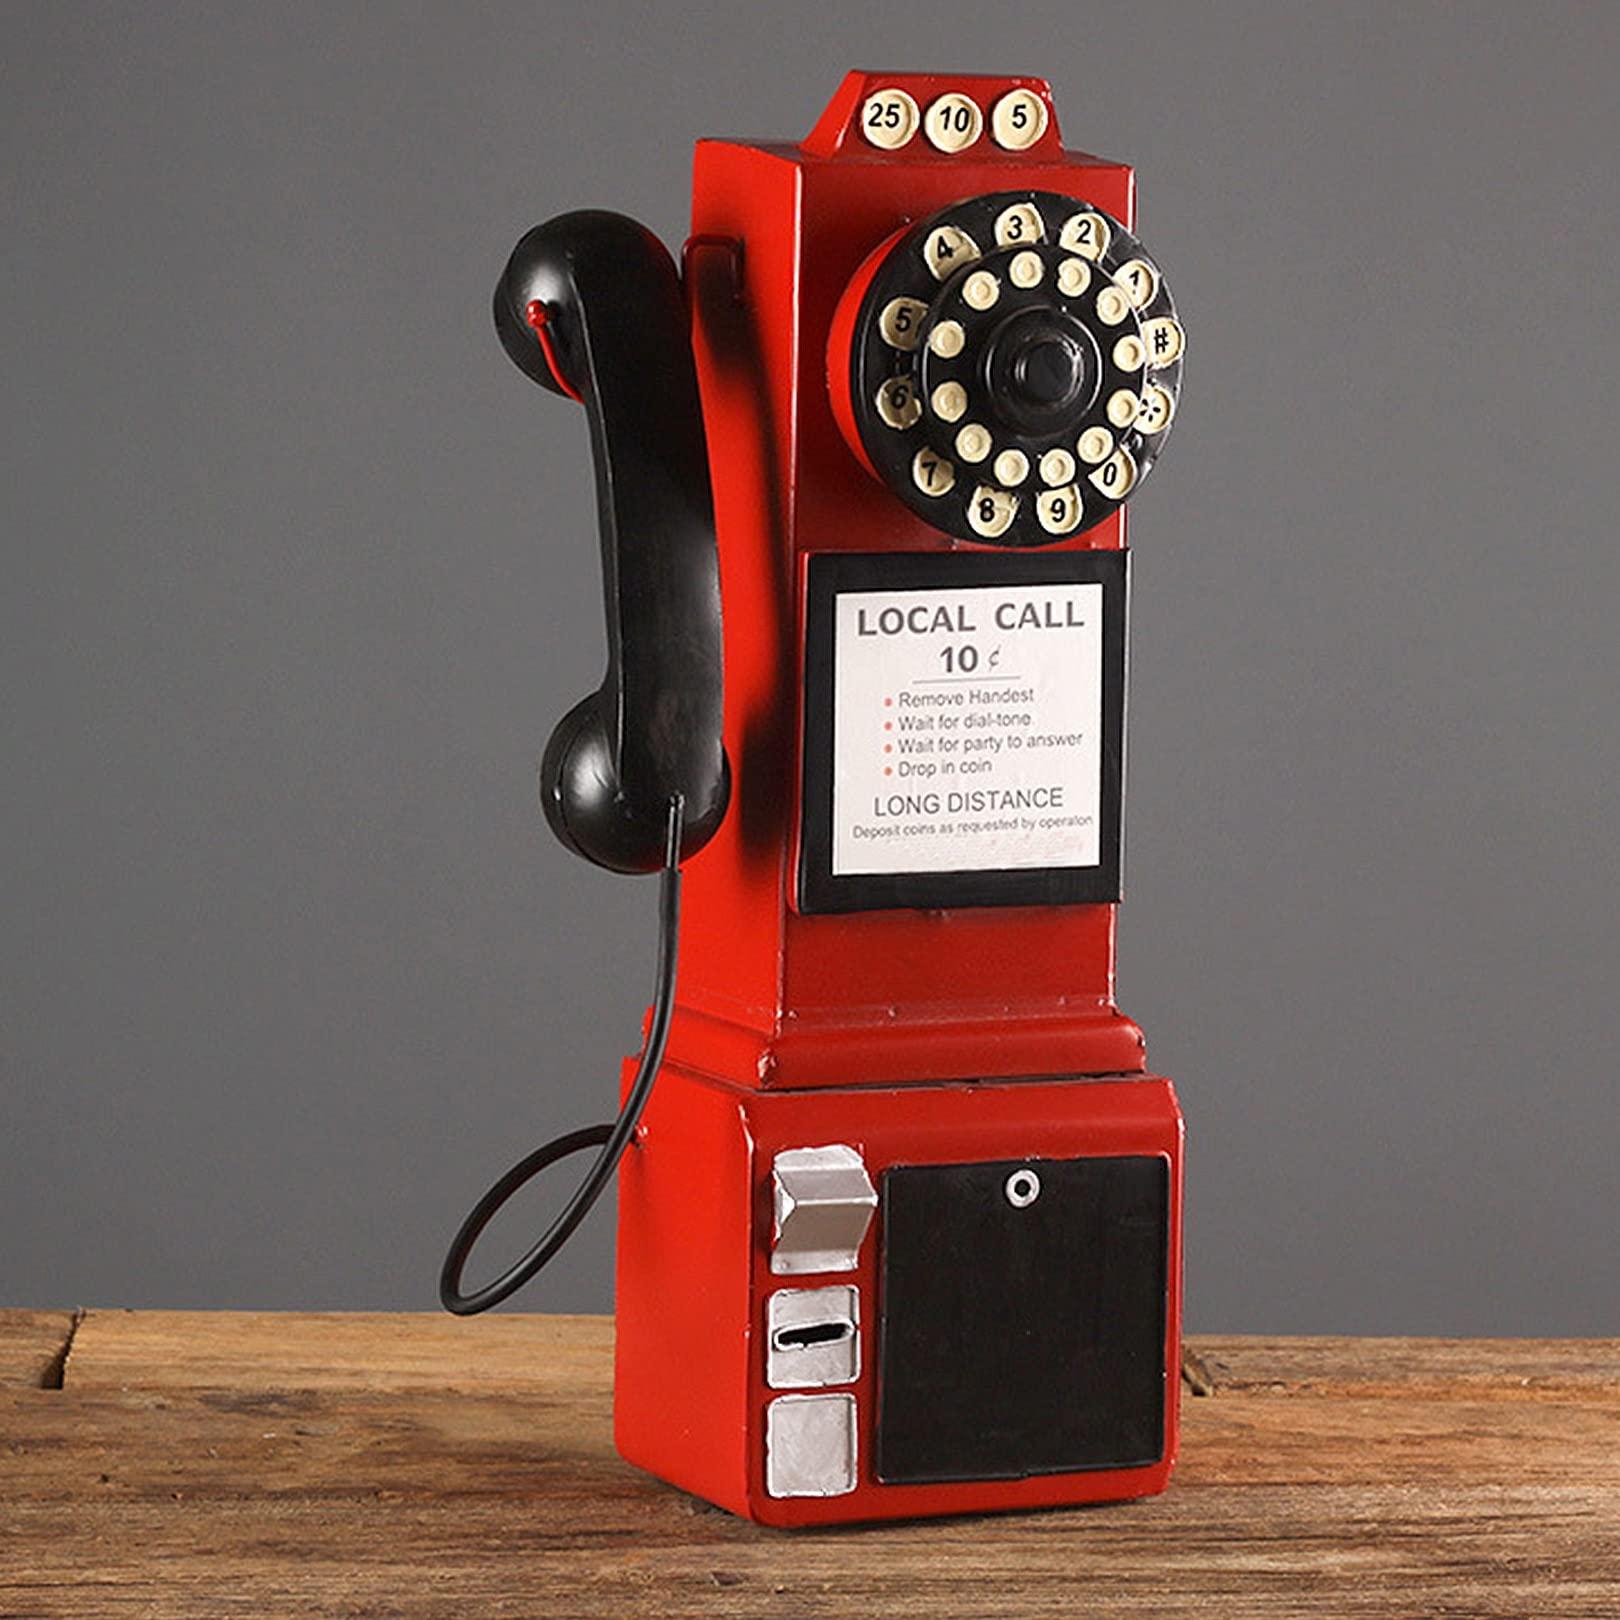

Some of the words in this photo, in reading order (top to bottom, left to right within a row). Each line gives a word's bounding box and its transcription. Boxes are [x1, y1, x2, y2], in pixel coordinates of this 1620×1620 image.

[868, 103, 900, 128] 25
[939, 106, 970, 132] 10
[1012, 104, 1028, 129] 5
[1007, 215, 1023, 240] 3
[1077, 219, 1091, 244] 2
[936, 235, 953, 259] 4
[1128, 270, 1140, 295] 1
[895, 307, 912, 332] 5
[1153, 327, 1169, 353] #
[891, 385, 908, 408] 6
[922, 462, 938, 486] 7
[1103, 464, 1116, 486] 0
[980, 499, 994, 523] 8
[1051, 498, 1065, 522] 9
[858, 605, 976, 636] LOCAL
[995, 601, 1085, 630] CALL
[940, 645, 978, 673] 10
[898, 691, 963, 708] Remove
[969, 688, 1034, 705] Handest
[898, 716, 934, 731] Wait
[938, 714, 959, 730] for
[964, 711, 1031, 729] dial-tone
[898, 738, 934, 754] Wait
[938, 736, 959, 752] for
[964, 736, 1003, 754] party
[1008, 734, 1022, 749] to
[1027, 733, 1083, 749] answer
[898, 760, 937, 778] Drop
[941, 760, 955, 775] in
[960, 758, 992, 773] coin
[874, 793, 940, 817] LONG
[948, 787, 1063, 813] DISTANCE
[853, 825, 900, 840] Deposit
[904, 824, 935, 837] coins
[940, 825, 953, 834] as
[957, 819, 1018, 835] requested
[1022, 817, 1035, 830] by
